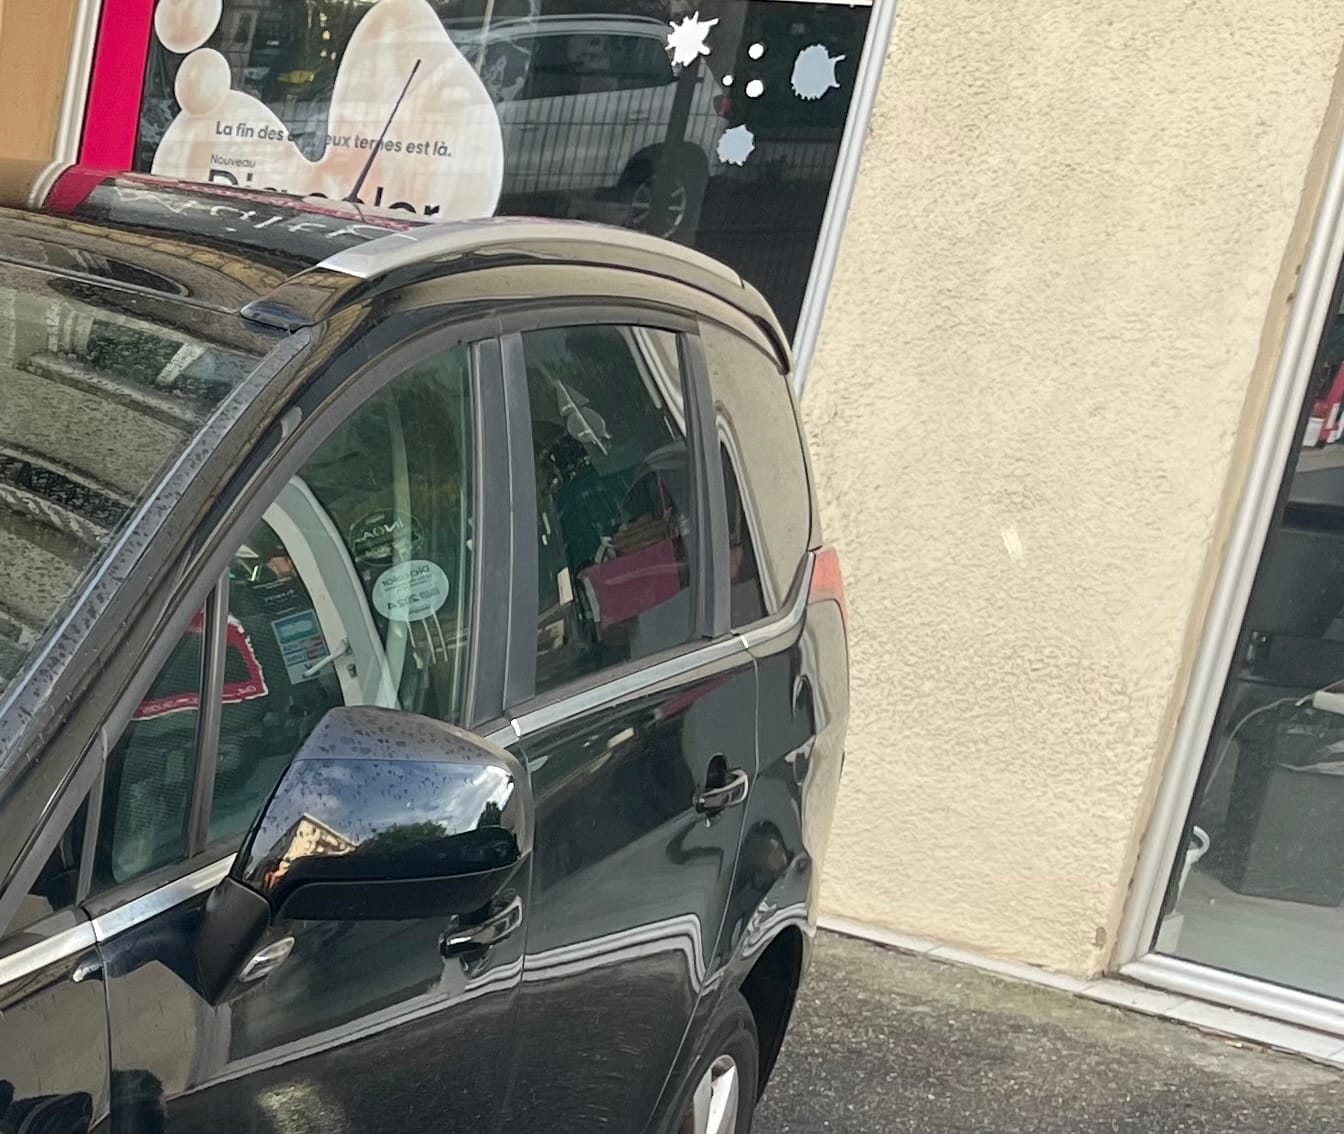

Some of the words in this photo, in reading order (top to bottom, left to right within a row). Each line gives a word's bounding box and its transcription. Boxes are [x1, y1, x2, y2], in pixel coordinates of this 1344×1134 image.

[216, 121, 232, 136] La
[236, 122, 254, 138] fin
[257, 125, 284, 141] des
[406, 141, 429, 155] est
[432, 140, 453, 157] là.
[210, 153, 256, 168] Nouveau
